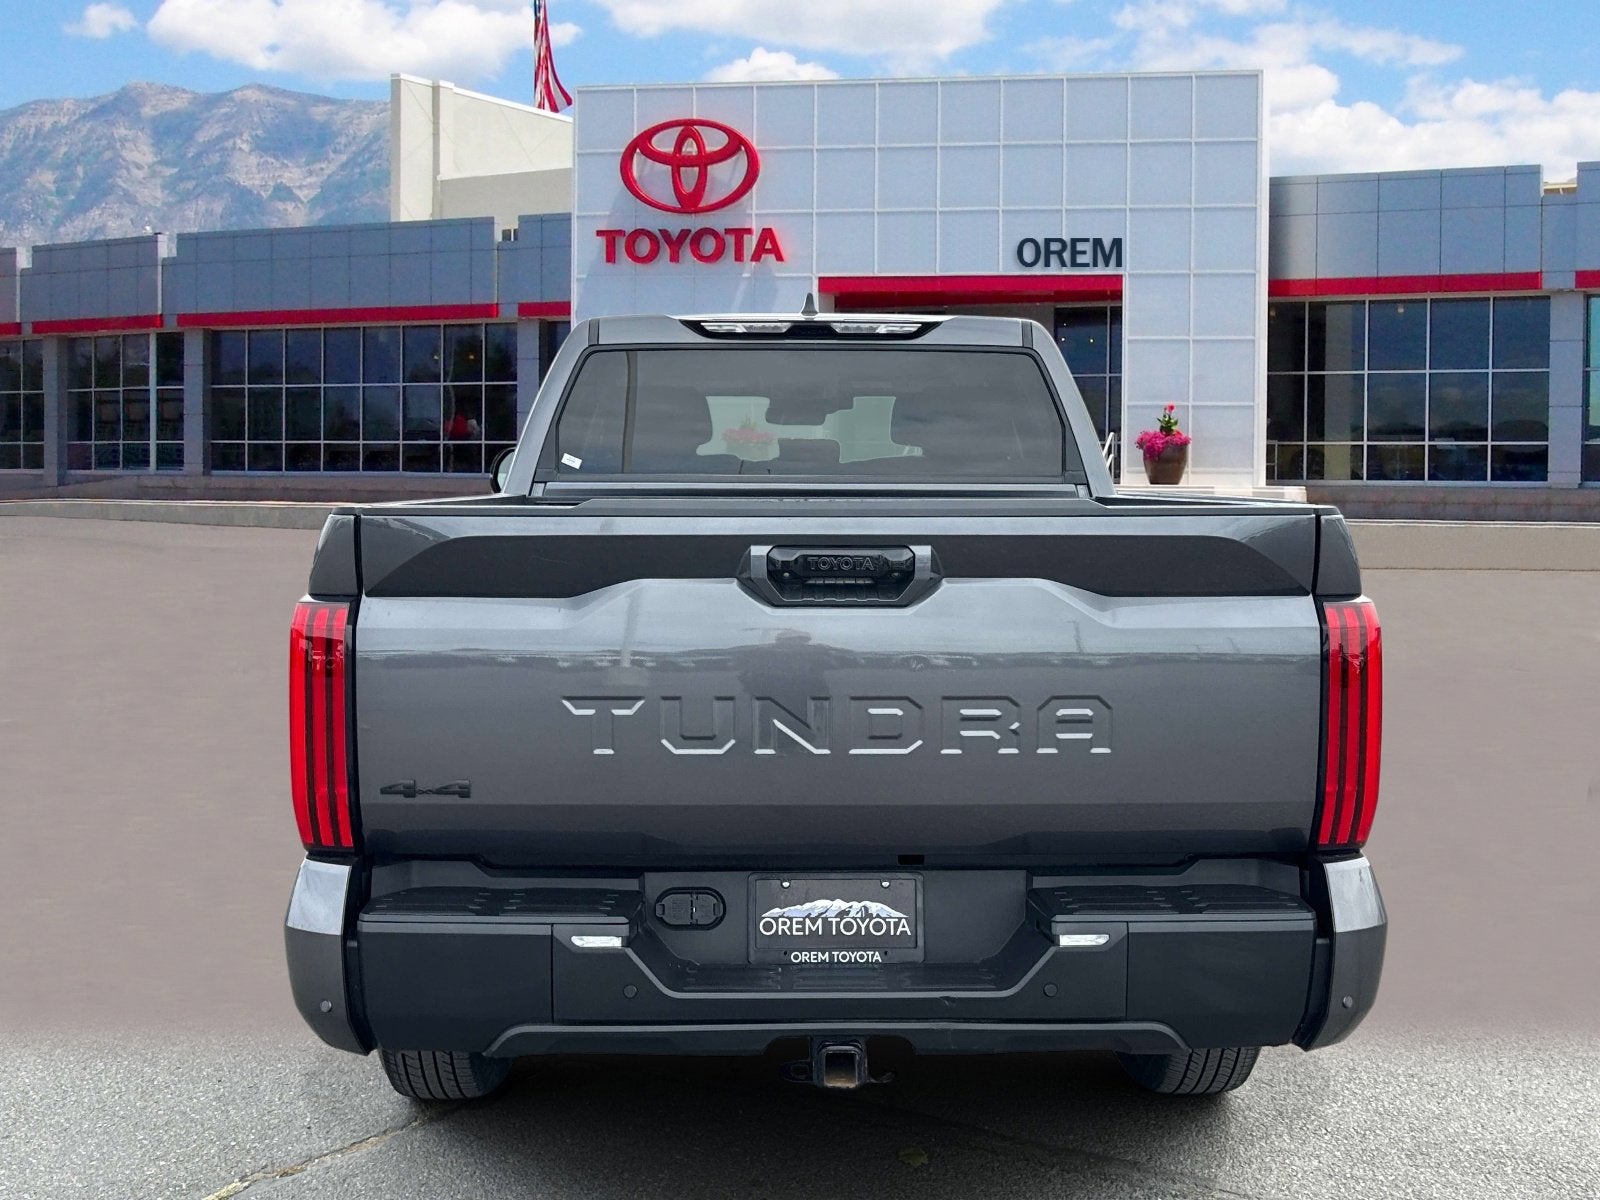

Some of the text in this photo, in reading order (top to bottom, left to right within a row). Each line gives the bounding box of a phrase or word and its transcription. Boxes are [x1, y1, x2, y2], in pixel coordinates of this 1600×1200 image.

[596, 227, 785, 264] TOYOTA
[1016, 237, 1123, 269] OREM
[807, 556, 875, 571] TOYOTA
[561, 695, 1113, 755] TUNDRA
[759, 917, 912, 936] OREM TOYOTA
[790, 951, 882, 963] OREM TOYOTA
